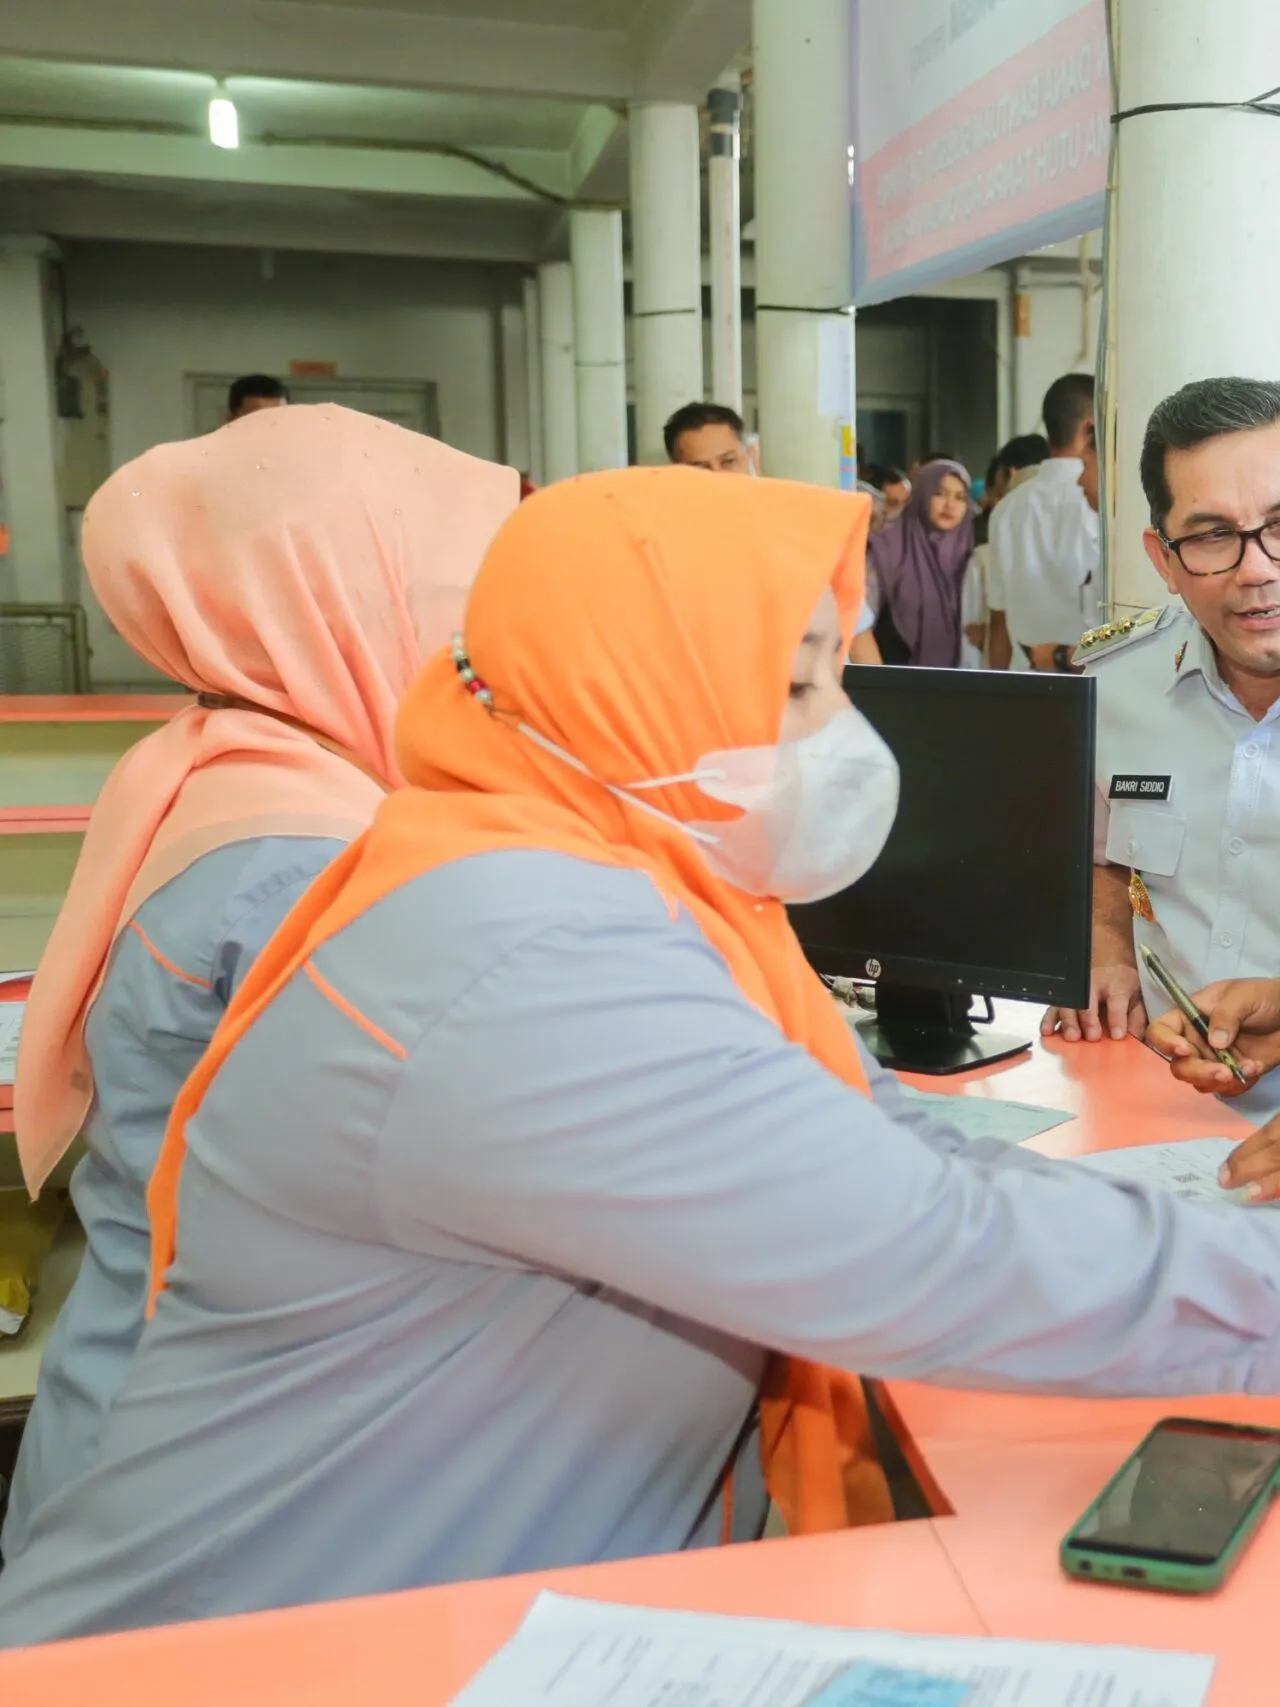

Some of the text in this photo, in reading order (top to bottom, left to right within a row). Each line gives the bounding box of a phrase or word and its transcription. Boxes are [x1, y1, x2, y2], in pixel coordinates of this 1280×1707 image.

[1115, 780, 1165, 793] BAKRI SIDDIQ
[868, 957, 881, 977] hp
